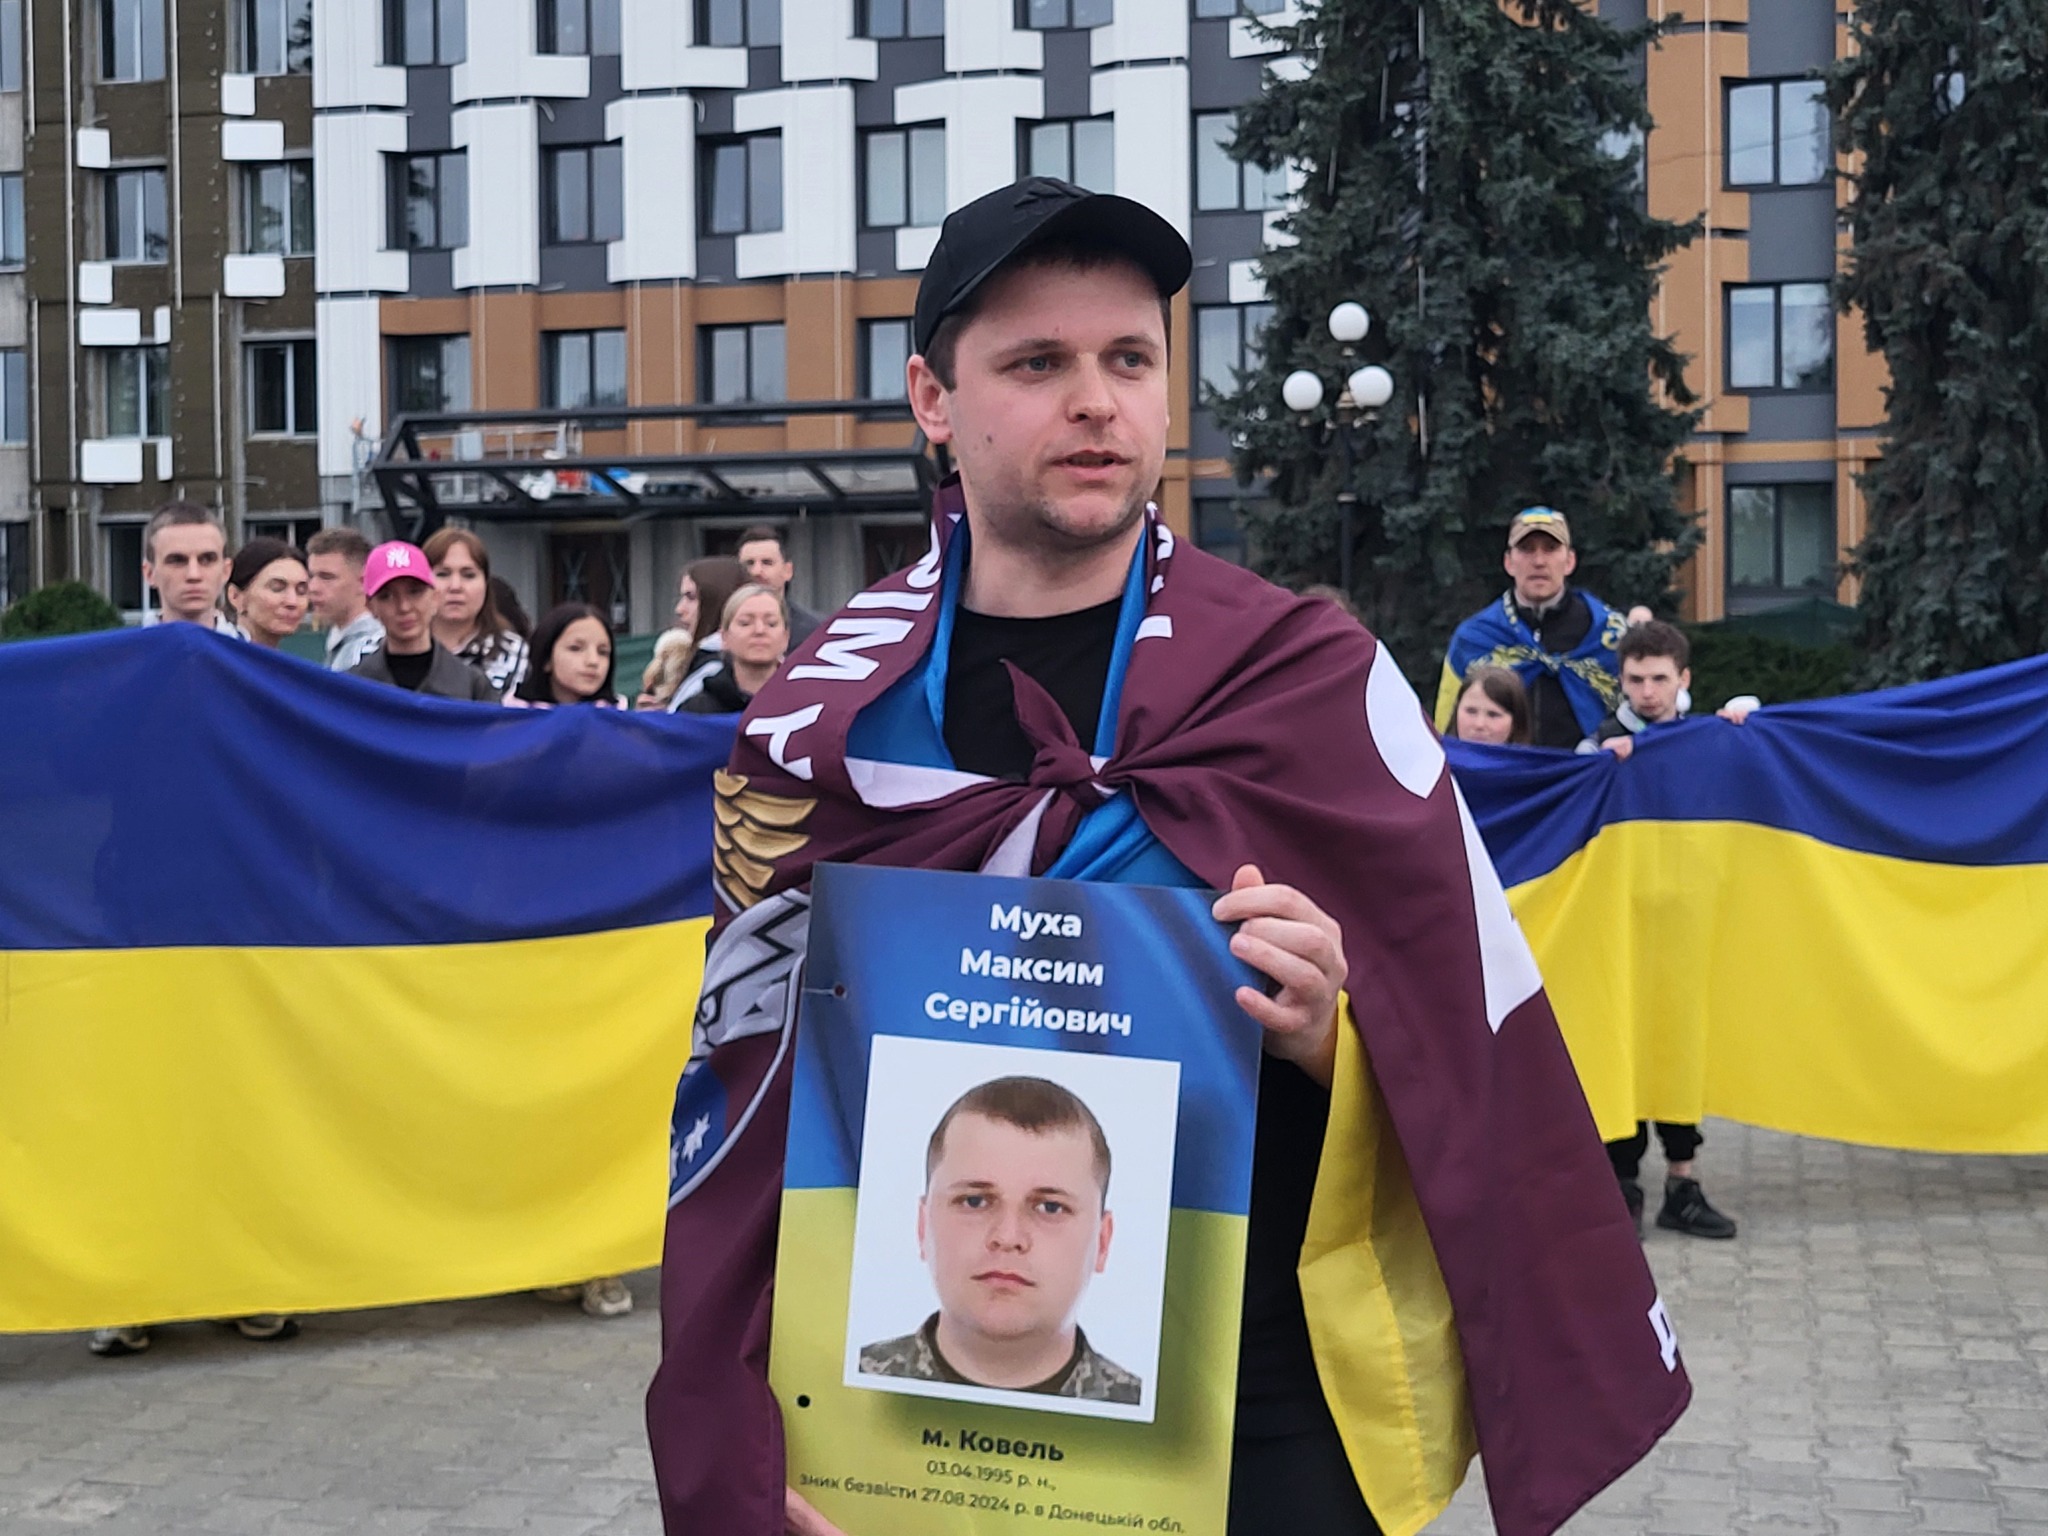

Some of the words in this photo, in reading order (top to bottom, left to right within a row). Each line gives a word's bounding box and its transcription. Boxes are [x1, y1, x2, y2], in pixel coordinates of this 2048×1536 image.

[990, 903, 1082, 940] Муха
[960, 948, 1104, 986] Максим
[924, 992, 1132, 1036] Сергійович
[922, 1428, 950, 1448] м.
[959, 1429, 1064, 1461] Ковель
[926, 1460, 1013, 1485] 03.04.1995
[844, 1477, 917, 1500] безвісти
[921, 1487, 1009, 1511] 27.08.2024
[1034, 1505, 1044, 1516] в
[1048, 1504, 1143, 1529] Донецькій
[1147, 1517, 1187, 1534] обл.
